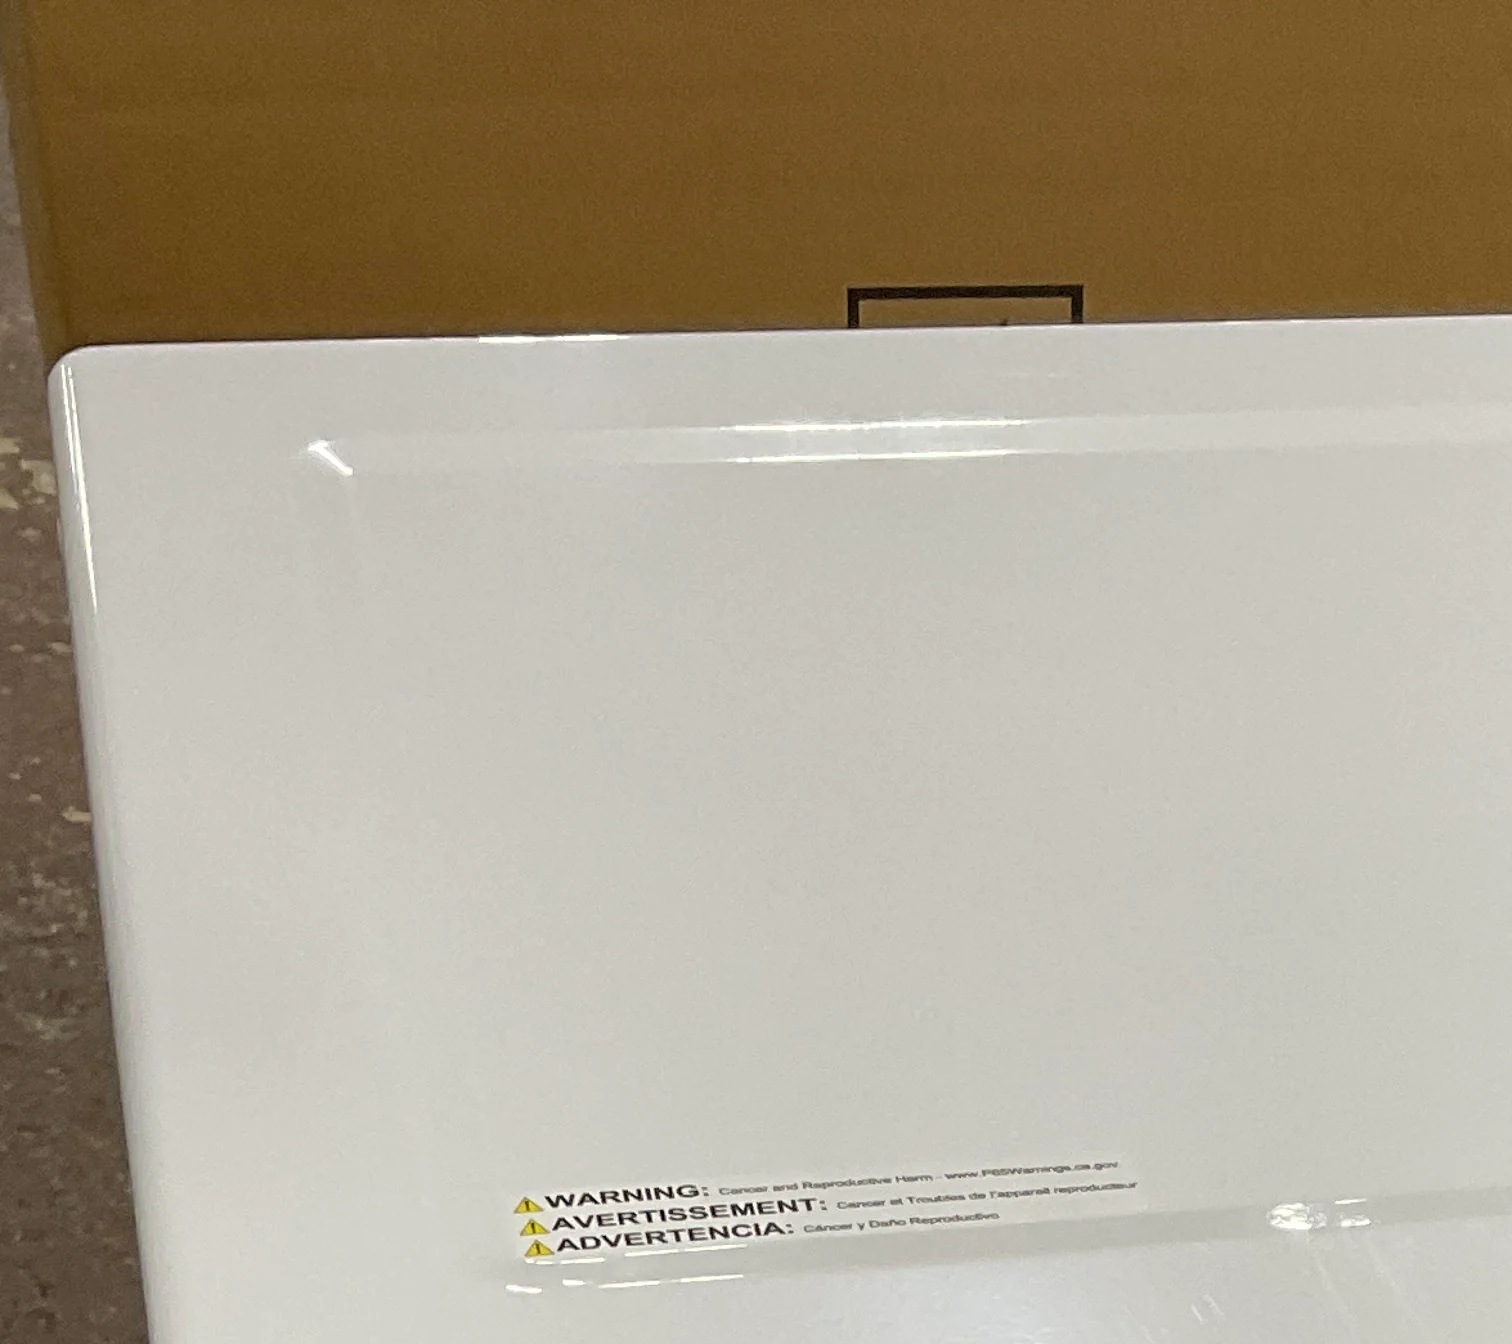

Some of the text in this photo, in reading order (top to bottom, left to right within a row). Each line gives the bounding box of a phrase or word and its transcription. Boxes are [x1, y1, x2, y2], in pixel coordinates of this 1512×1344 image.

[545, 1184, 710, 1209] WARNING:
[718, 1185, 768, 1196] Cancer
[773, 1183, 799, 1192] and
[802, 1177, 892, 1191] Reproductive
[896, 1173, 933, 1184] Harm
[551, 1197, 828, 1232] AVERTISSEMENT:
[836, 1199, 886, 1210] Cancer
[890, 1197, 904, 1207] et
[968, 1192, 987, 1201] de
[556, 1221, 794, 1252] ADVERTENCIA:
[857, 1222, 866, 1231] y
[909, 1212, 1000, 1225] Reproductivo
